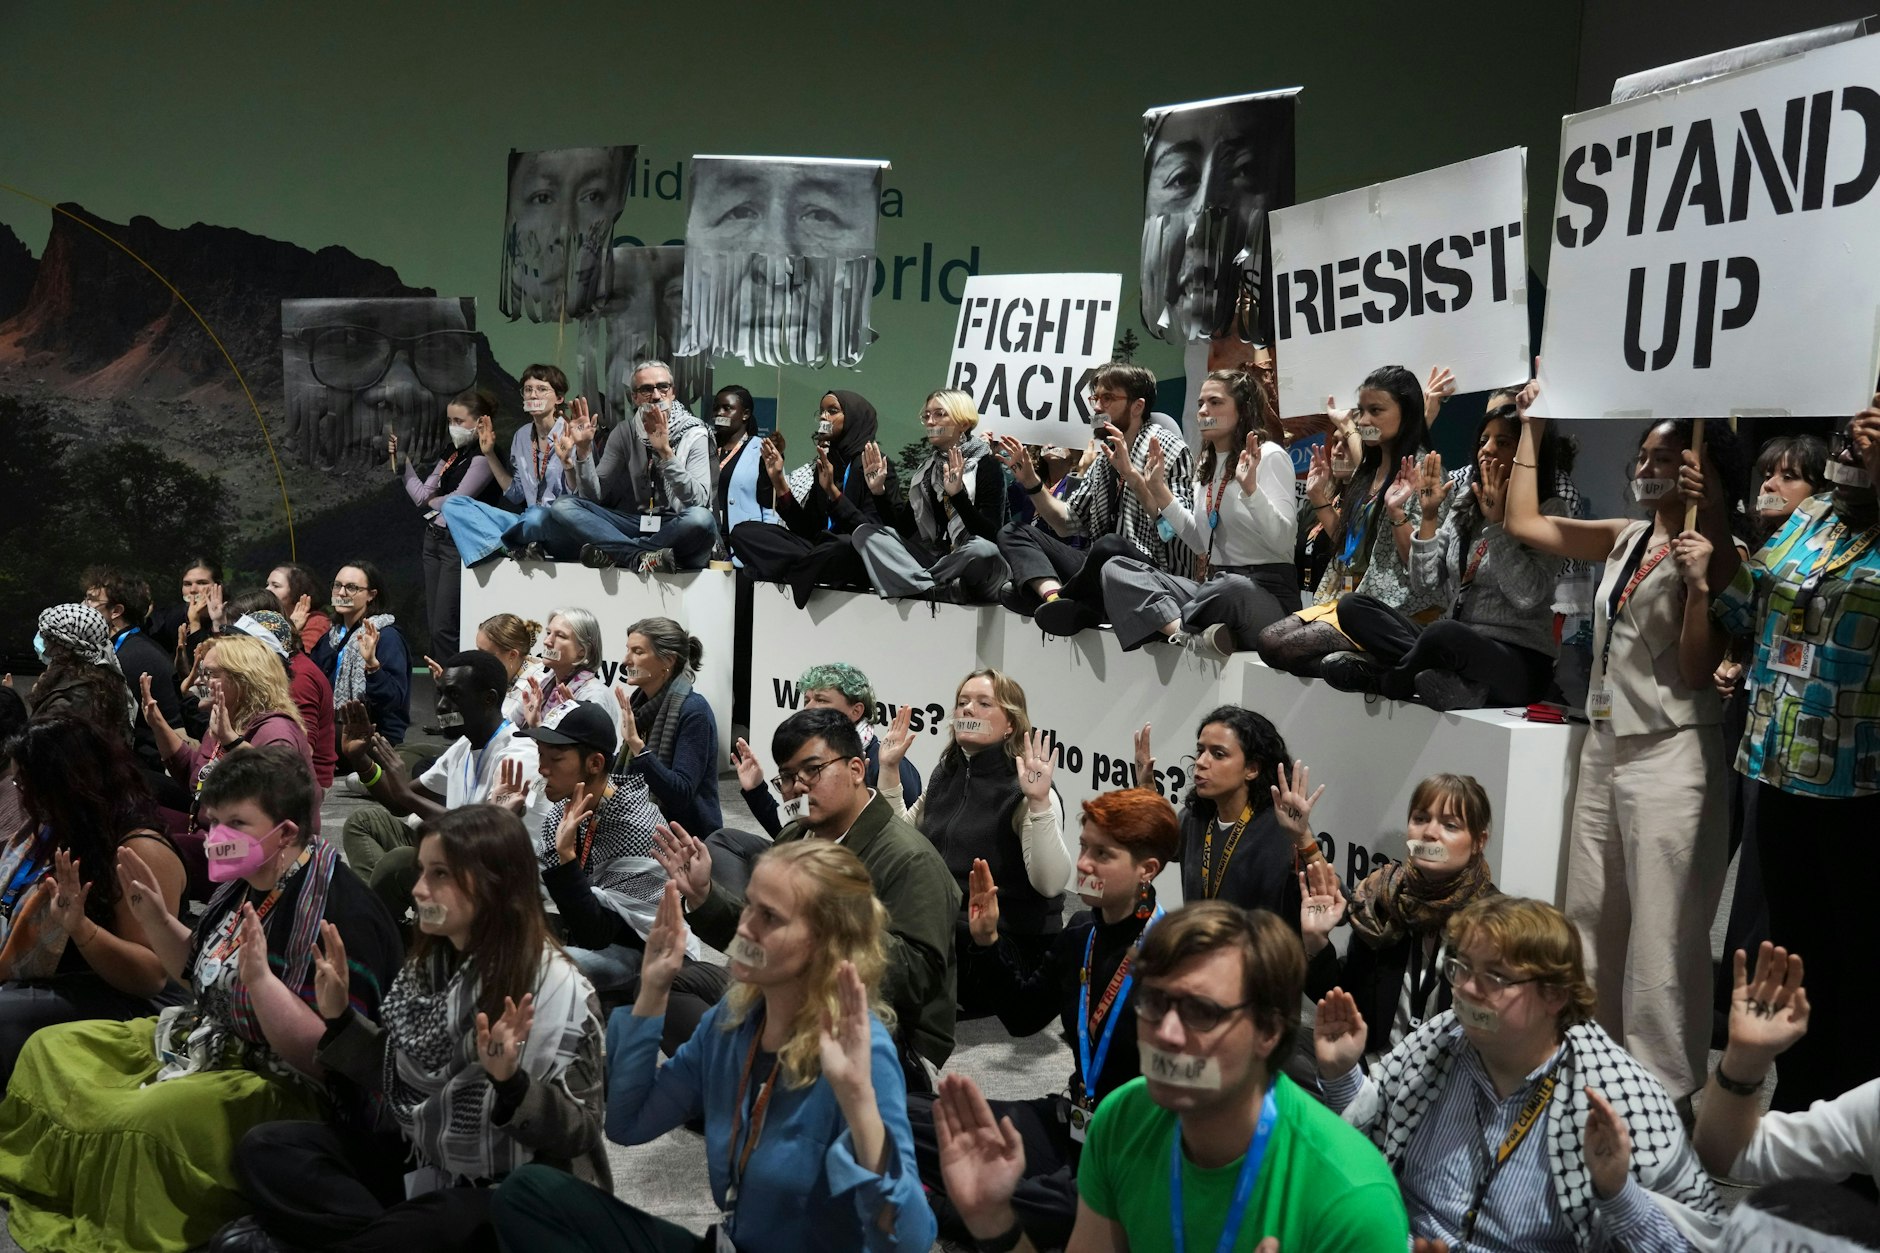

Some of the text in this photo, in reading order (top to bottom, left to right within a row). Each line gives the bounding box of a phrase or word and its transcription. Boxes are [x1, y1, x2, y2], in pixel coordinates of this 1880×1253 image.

[1556, 86, 1880, 248] STAND
[1277, 221, 1521, 340] RESIST
[957, 297, 1112, 356] FIGHT
[1624, 256, 1760, 372] UP
[952, 362, 1098, 428] BACK
[1851, 522, 1880, 553] CLIMAT
[967, 721, 982, 730] UP!
[215, 843, 237, 857] UP!
[1306, 904, 1330, 916] PAY
[1743, 997, 1780, 1021] PAY
[1152, 1053, 1207, 1080] PAY UP
[1504, 1080, 1552, 1148] FOR CLIMATE
